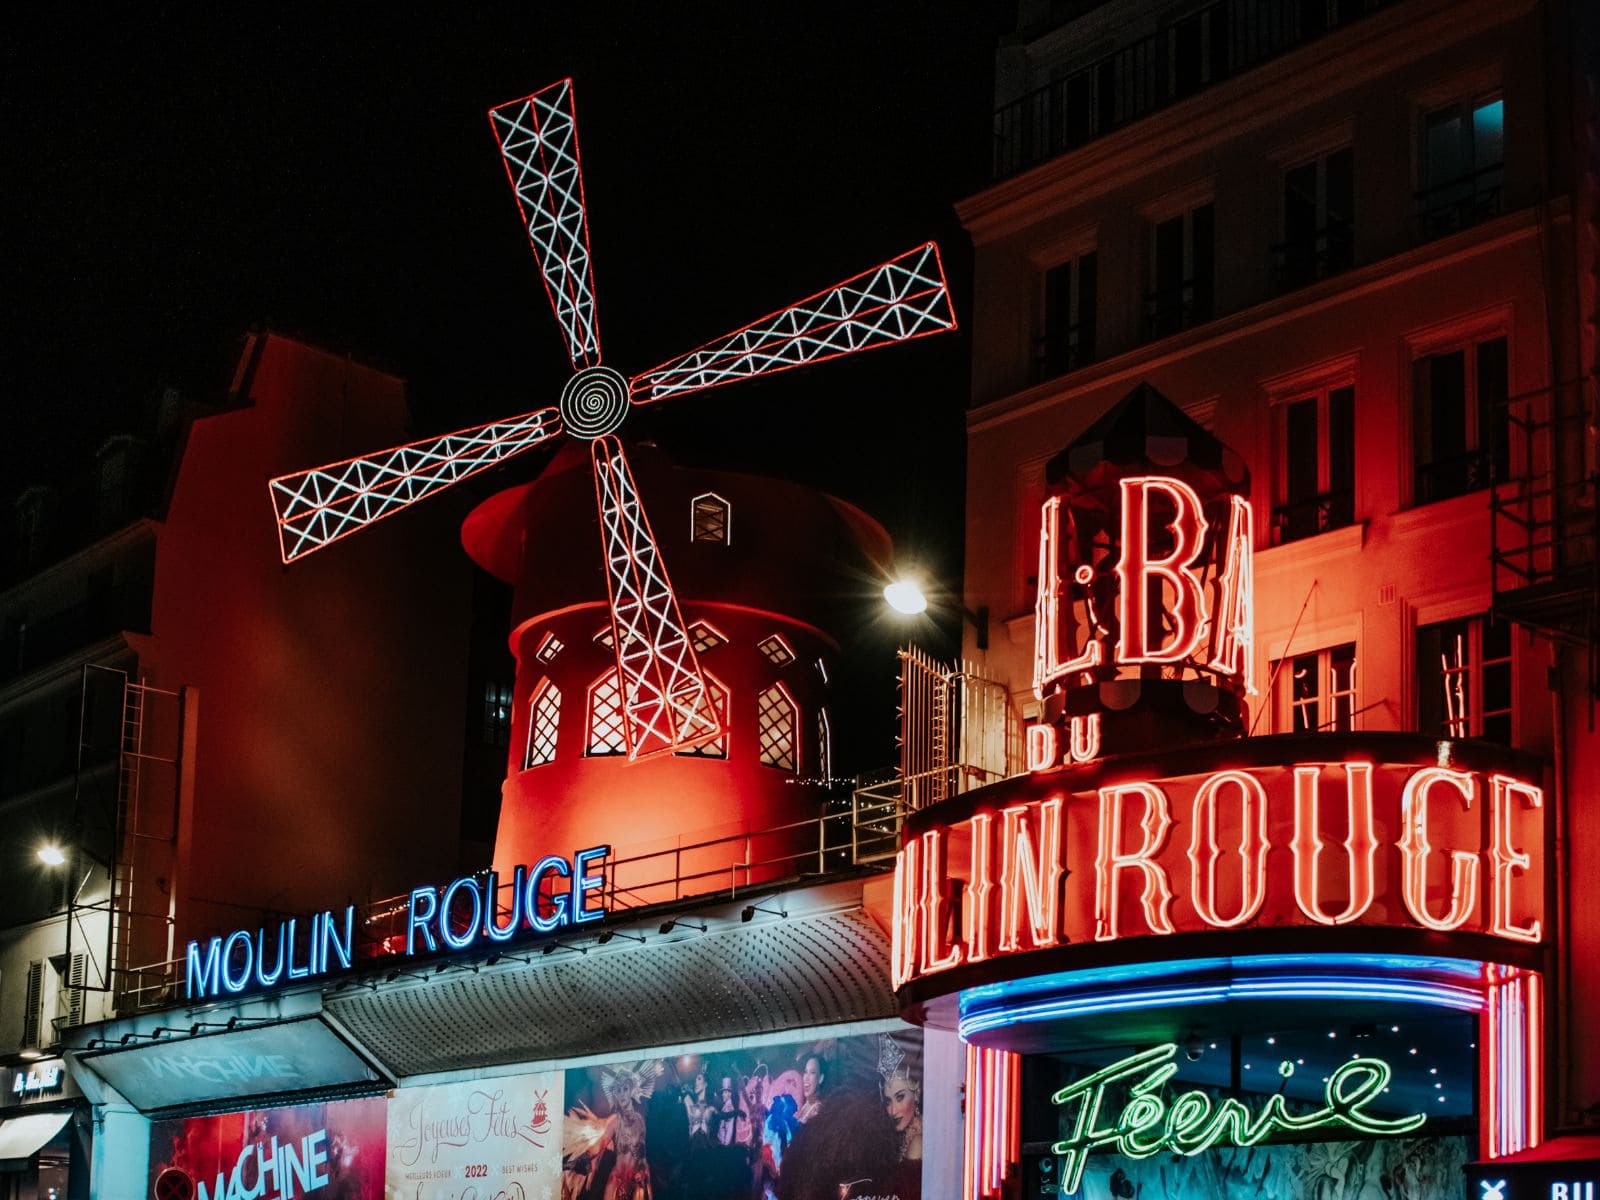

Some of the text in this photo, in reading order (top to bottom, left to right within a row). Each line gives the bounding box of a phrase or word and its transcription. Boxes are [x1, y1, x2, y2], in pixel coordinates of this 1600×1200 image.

[1026, 713, 1099, 771] DU
[1094, 763, 1544, 943] ROUGE
[186, 844, 611, 1000] MOULIN ROUGE
[197, 1129, 329, 1200] MACHINE
[465, 1164, 488, 1178] 2022
[502, 1164, 516, 1174] BEST
